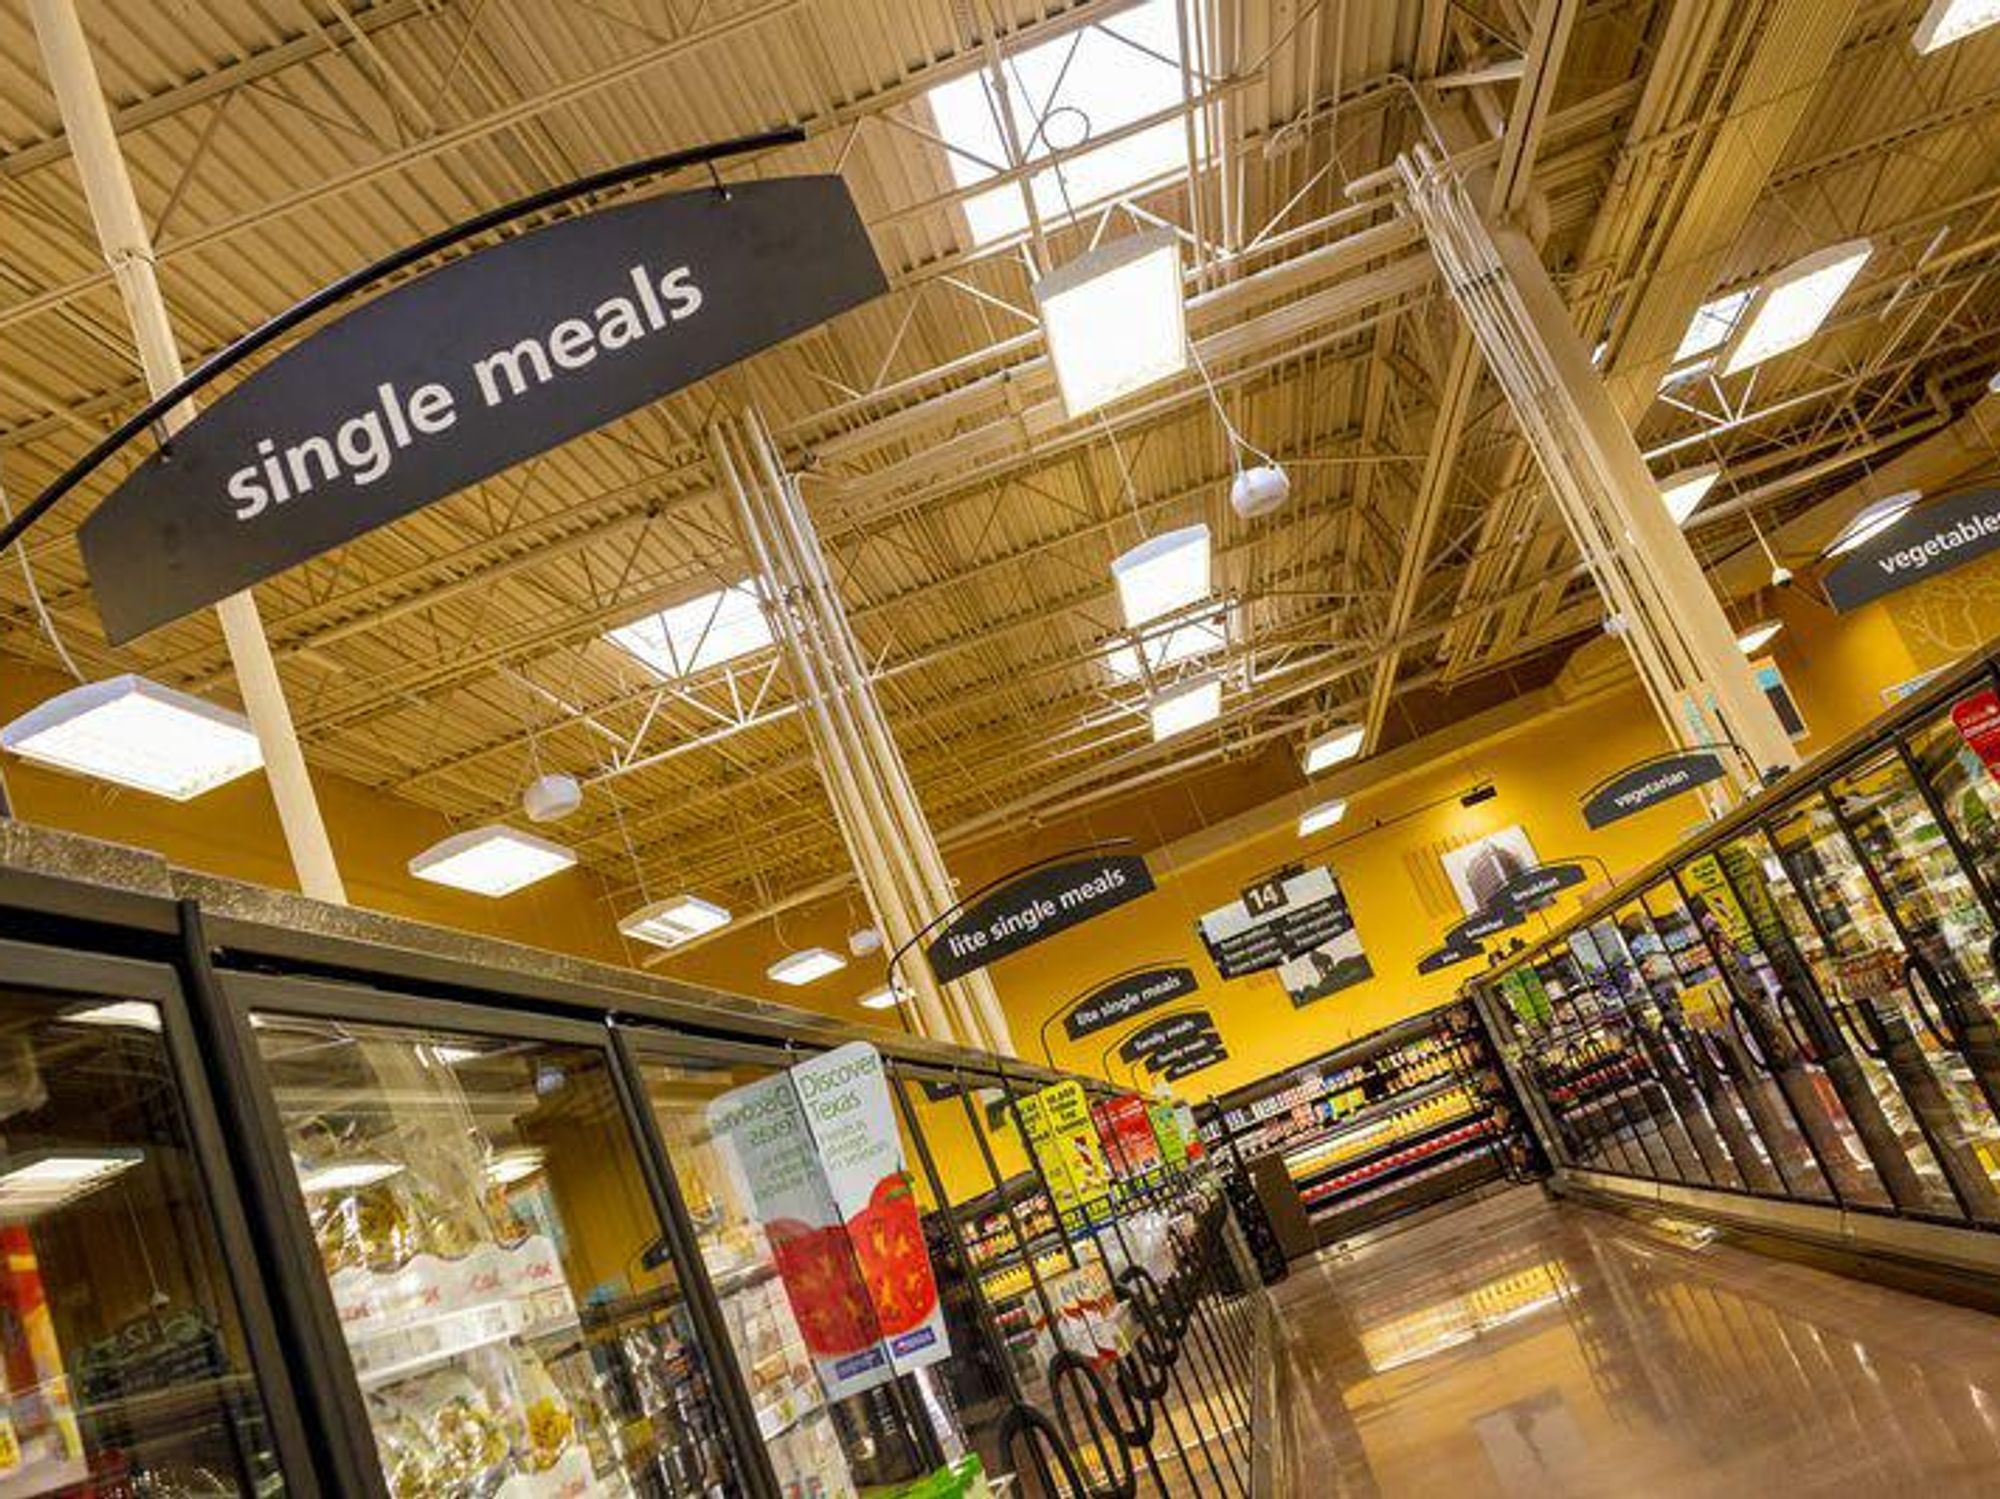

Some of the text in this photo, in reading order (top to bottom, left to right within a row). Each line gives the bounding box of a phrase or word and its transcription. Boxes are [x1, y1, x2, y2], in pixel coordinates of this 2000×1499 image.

[226, 264, 703, 520] single meals
[1614, 771, 1689, 807] vegetarian
[950, 868, 1126, 958] lite single meals
[1248, 882, 1279, 910] 14
[1101, 993, 1140, 1016] single
[1141, 975, 1181, 999] meals
[800, 1054, 878, 1098] Discover
[808, 1092, 861, 1121] Texas
